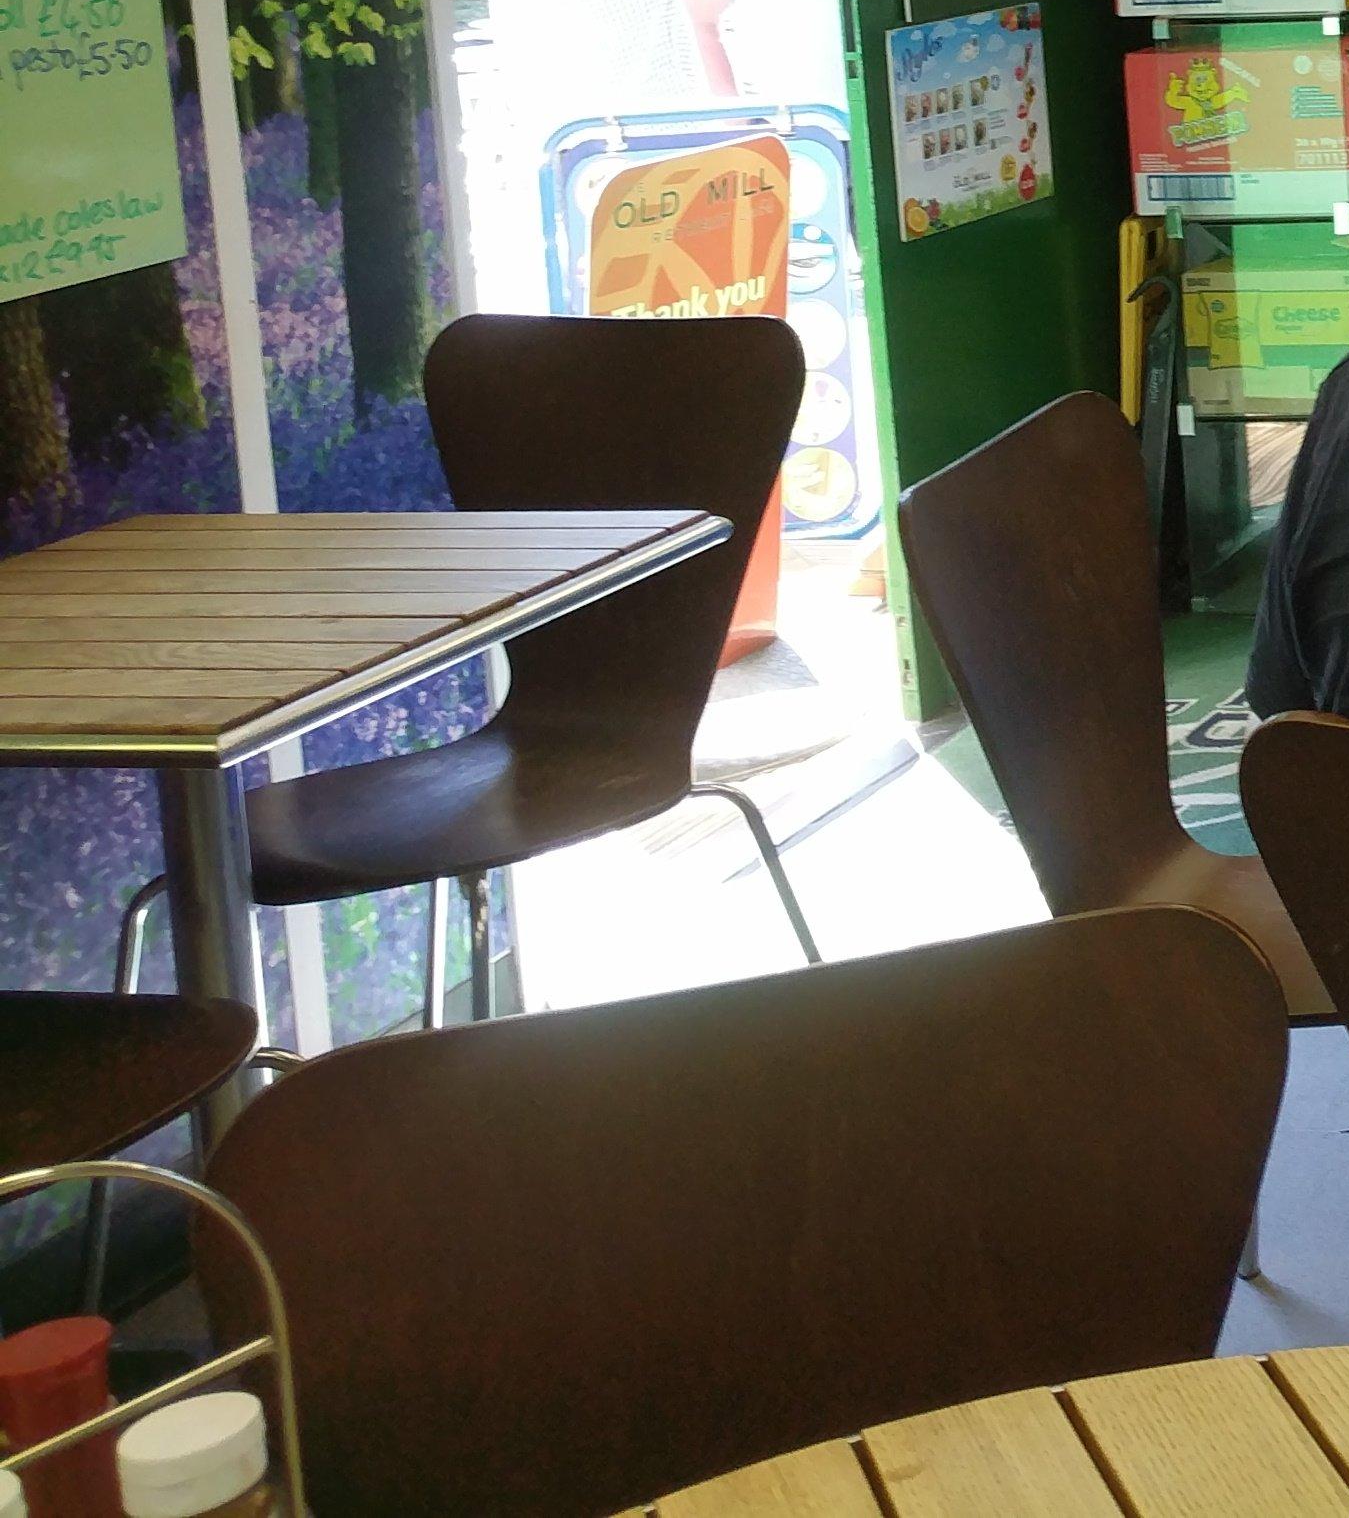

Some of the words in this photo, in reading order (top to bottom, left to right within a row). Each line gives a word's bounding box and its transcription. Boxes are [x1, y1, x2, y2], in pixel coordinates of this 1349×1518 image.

[613, 190, 680, 229] OLD
[707, 168, 775, 205] MILL
[714, 275, 767, 318] you
[1272, 305, 1341, 323] Cheese
